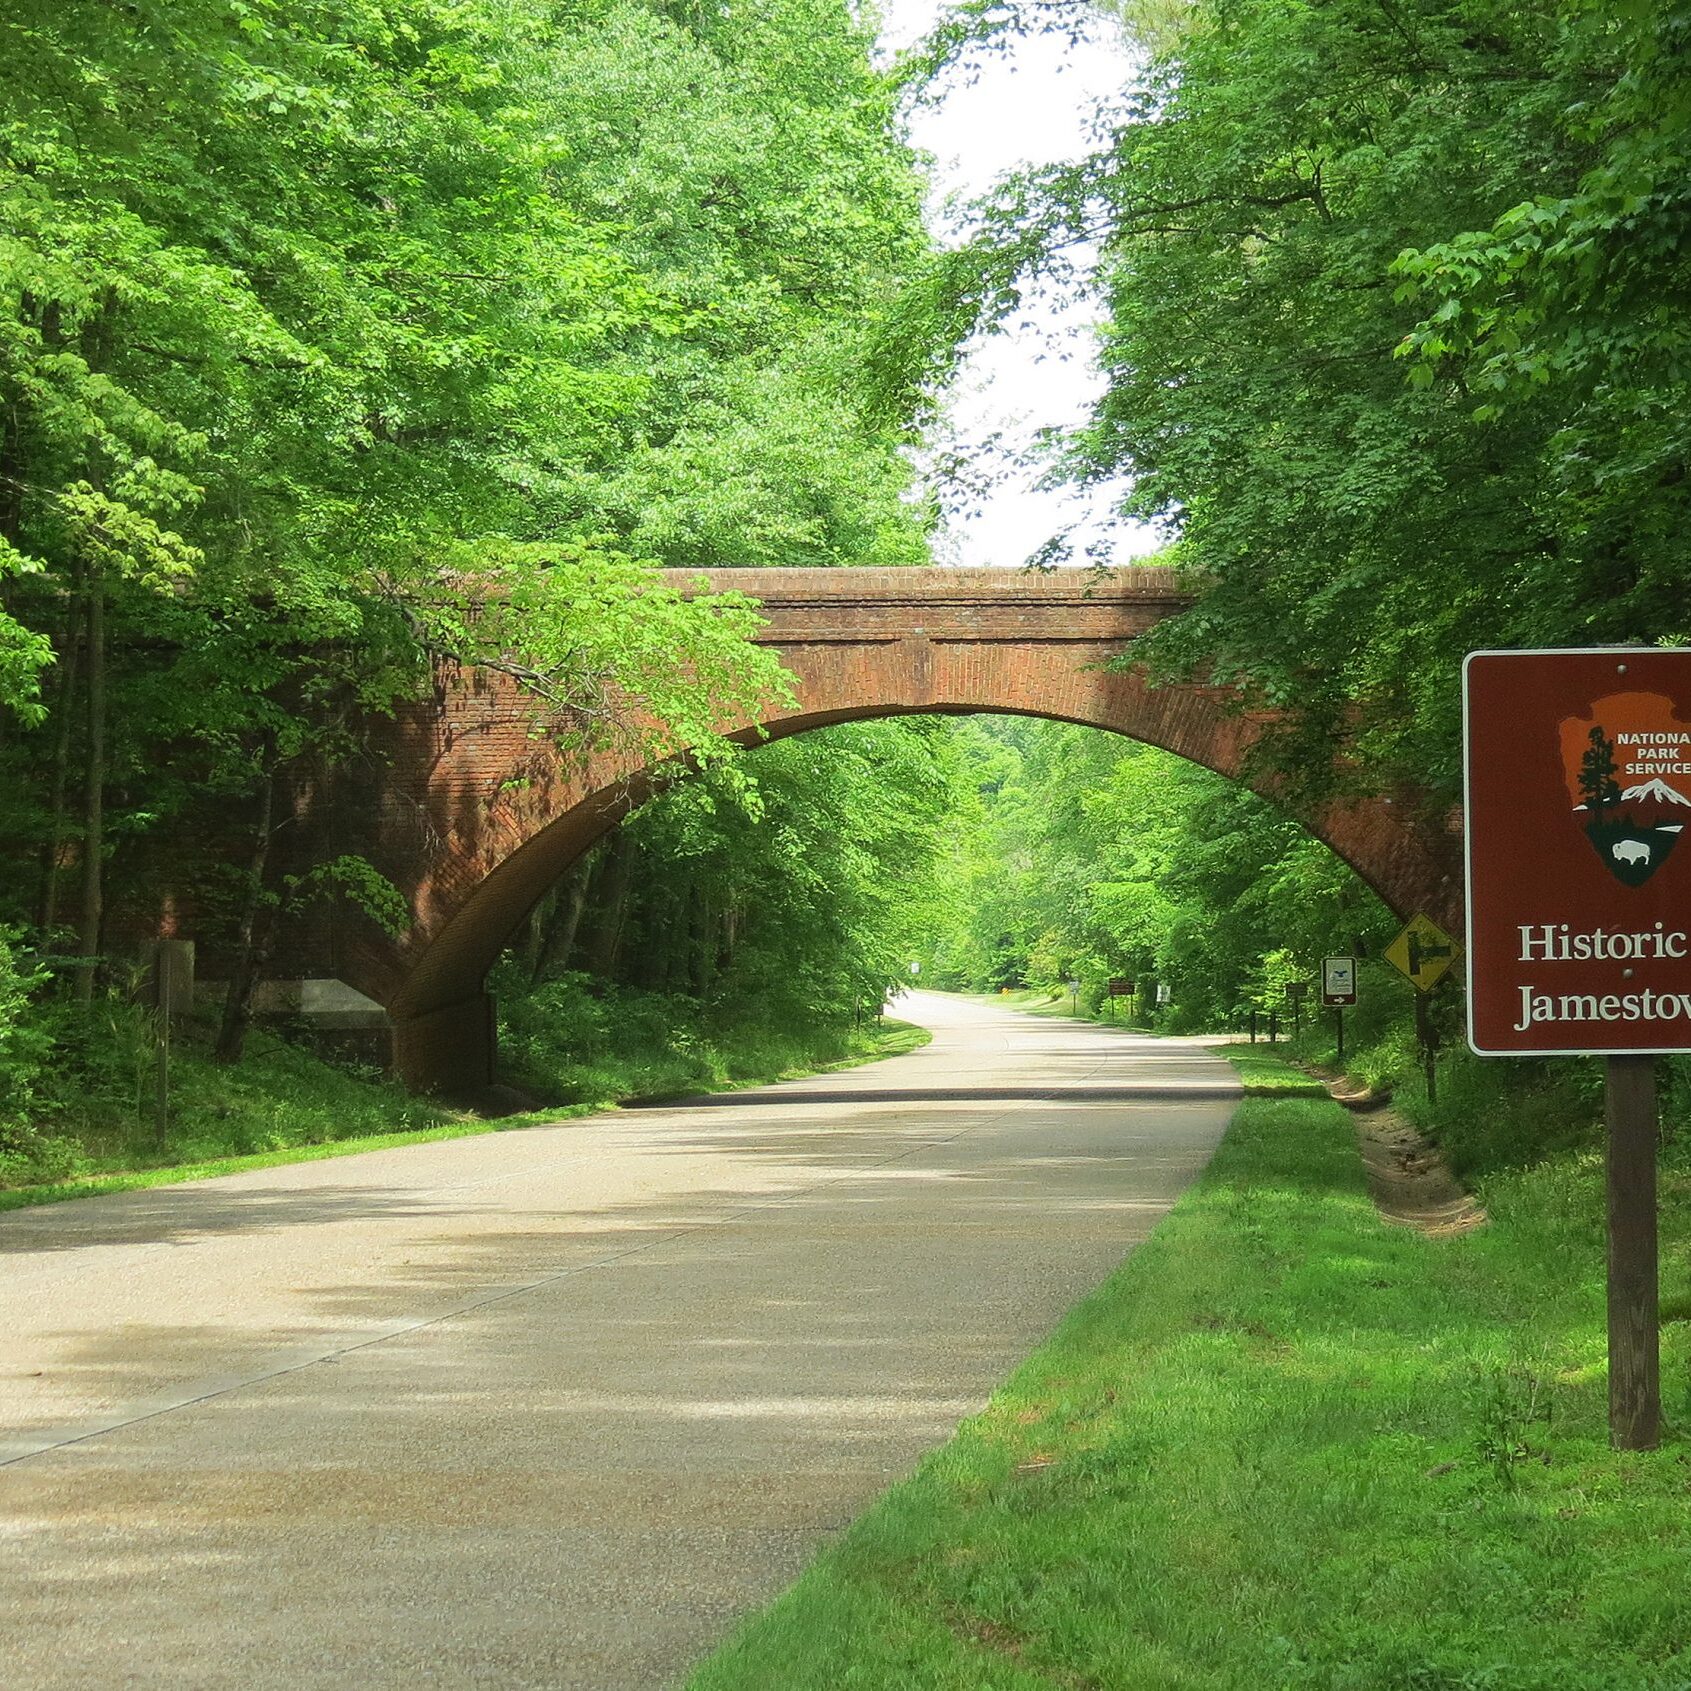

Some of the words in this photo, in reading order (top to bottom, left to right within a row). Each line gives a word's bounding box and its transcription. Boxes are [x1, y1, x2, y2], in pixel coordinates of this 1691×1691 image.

[1637, 748, 1680, 759] PARK
[1625, 763, 1691, 775] SERVICE
[1517, 921, 1688, 961] Historic
